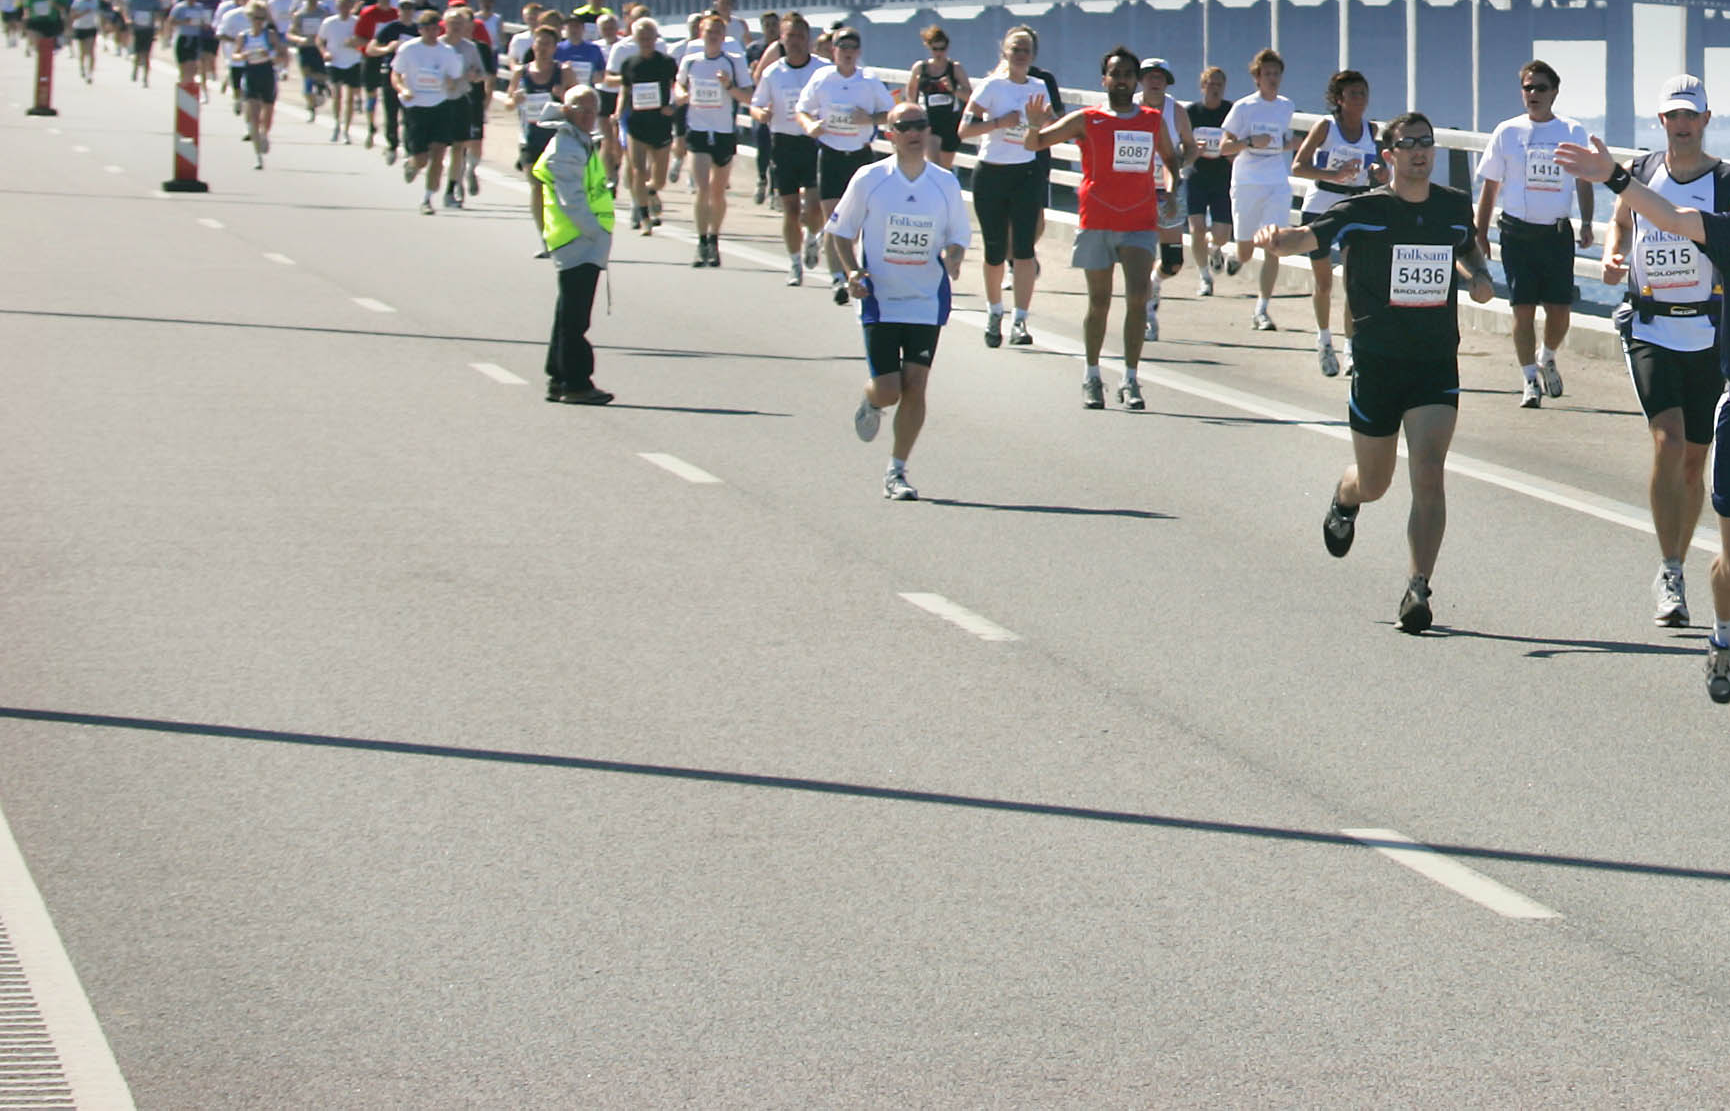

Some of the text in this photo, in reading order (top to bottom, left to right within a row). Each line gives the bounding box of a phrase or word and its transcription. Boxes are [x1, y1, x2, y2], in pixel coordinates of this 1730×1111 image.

[1119, 146, 1150, 158] 6087
[1531, 164, 1560, 177] 1414
[889, 215, 934, 228] Folksam
[890, 231, 928, 247] 2445
[1396, 248, 1449, 261] Folksam
[1645, 248, 1691, 266] 5515
[1398, 267, 1445, 284] 5436
